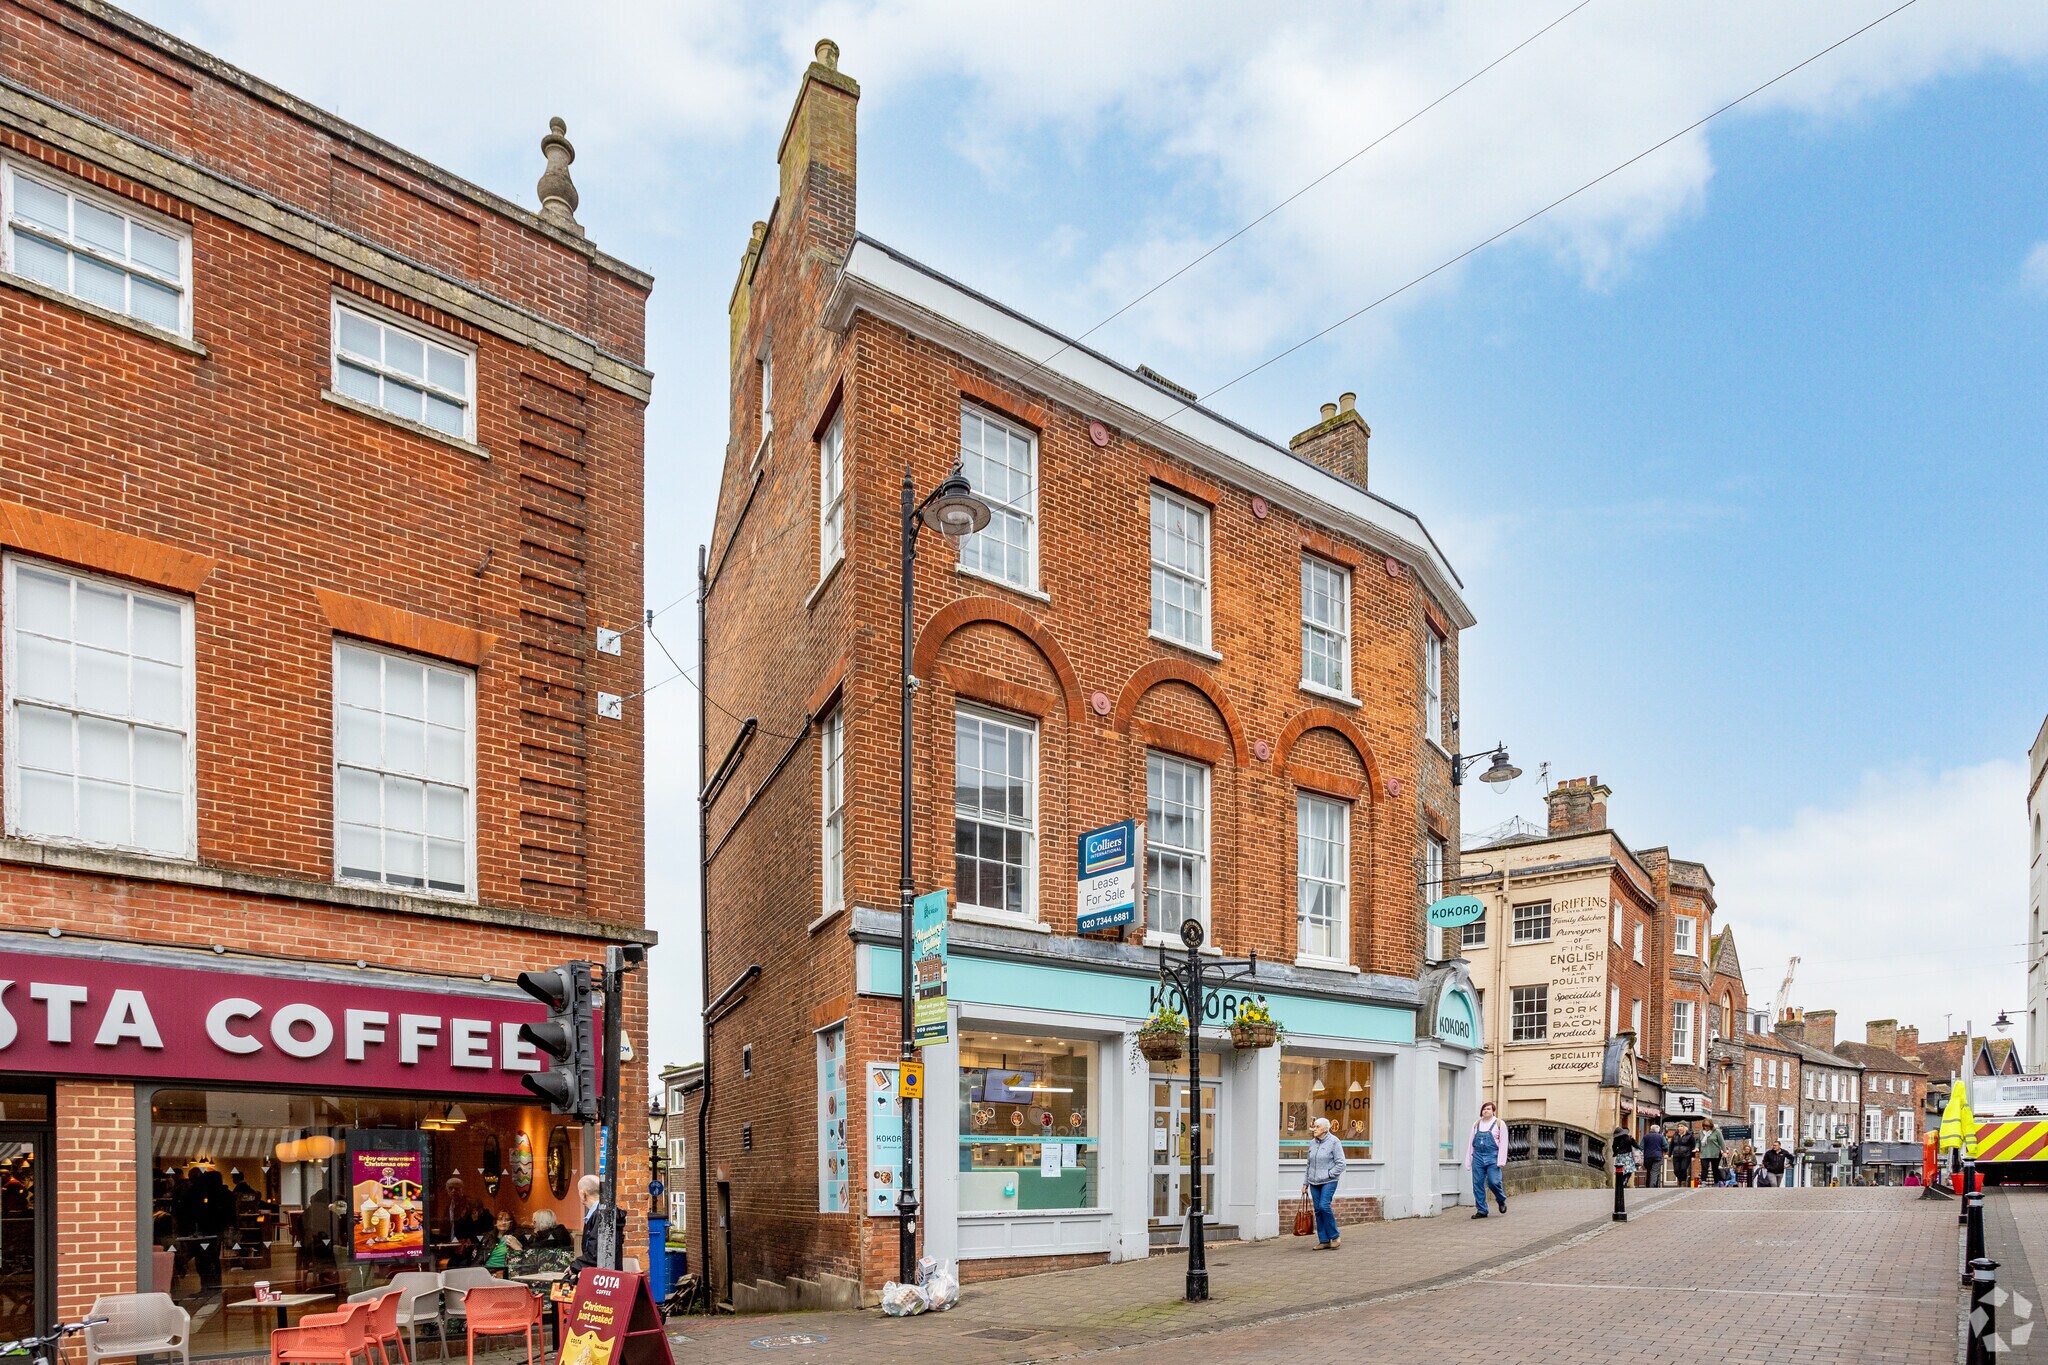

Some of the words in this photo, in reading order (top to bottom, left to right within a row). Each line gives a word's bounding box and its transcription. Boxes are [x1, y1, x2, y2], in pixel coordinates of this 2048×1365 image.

[1090, 838, 1122, 853] Colliers
[1090, 847, 1122, 859] INTERNATIONAL
[1092, 876, 1119, 891] Lease
[1086, 894, 1102, 907] For
[1104, 888, 1125, 903] Sale
[1553, 896, 1607, 913] GRIFFINS
[1431, 904, 1479, 919] KOKORO
[1082, 919, 1095, 929] 020
[1096, 915, 1112, 926] 7344
[1113, 911, 1130, 922] 6881
[1552, 916, 1576, 925] Family
[1577, 914, 1606, 922] Butchers
[1556, 927, 1602, 937] Purveyors
[1561, 944, 1593, 952] FINE
[1550, 951, 1604, 965] ENGLISH
[1561, 963, 1594, 973] MEAT
[1552, 975, 1602, 986] POULTRY
[1554, 990, 1602, 1002] Specialists
[1553, 1005, 1598, 1015] PORK
[1439, 1015, 1470, 1039] KOKORO
[1552, 1019, 1602, 1029] BACON
[205, 997, 541, 1072] COFFEE
[1552, 1028, 1597, 1039] products
[1549, 1051, 1602, 1060] SPECIALITY
[1547, 1061, 1600, 1072] sausages
[876, 1134, 902, 1142] KOKOR
[358, 1154, 376, 1163] Enjoy
[593, 1274, 620, 1289] COSTA
[596, 1288, 612, 1297] COFFEE
[582, 1300, 614, 1314] Christmas
[576, 1310, 590, 1321] just
[590, 1314, 614, 1325] peaked
